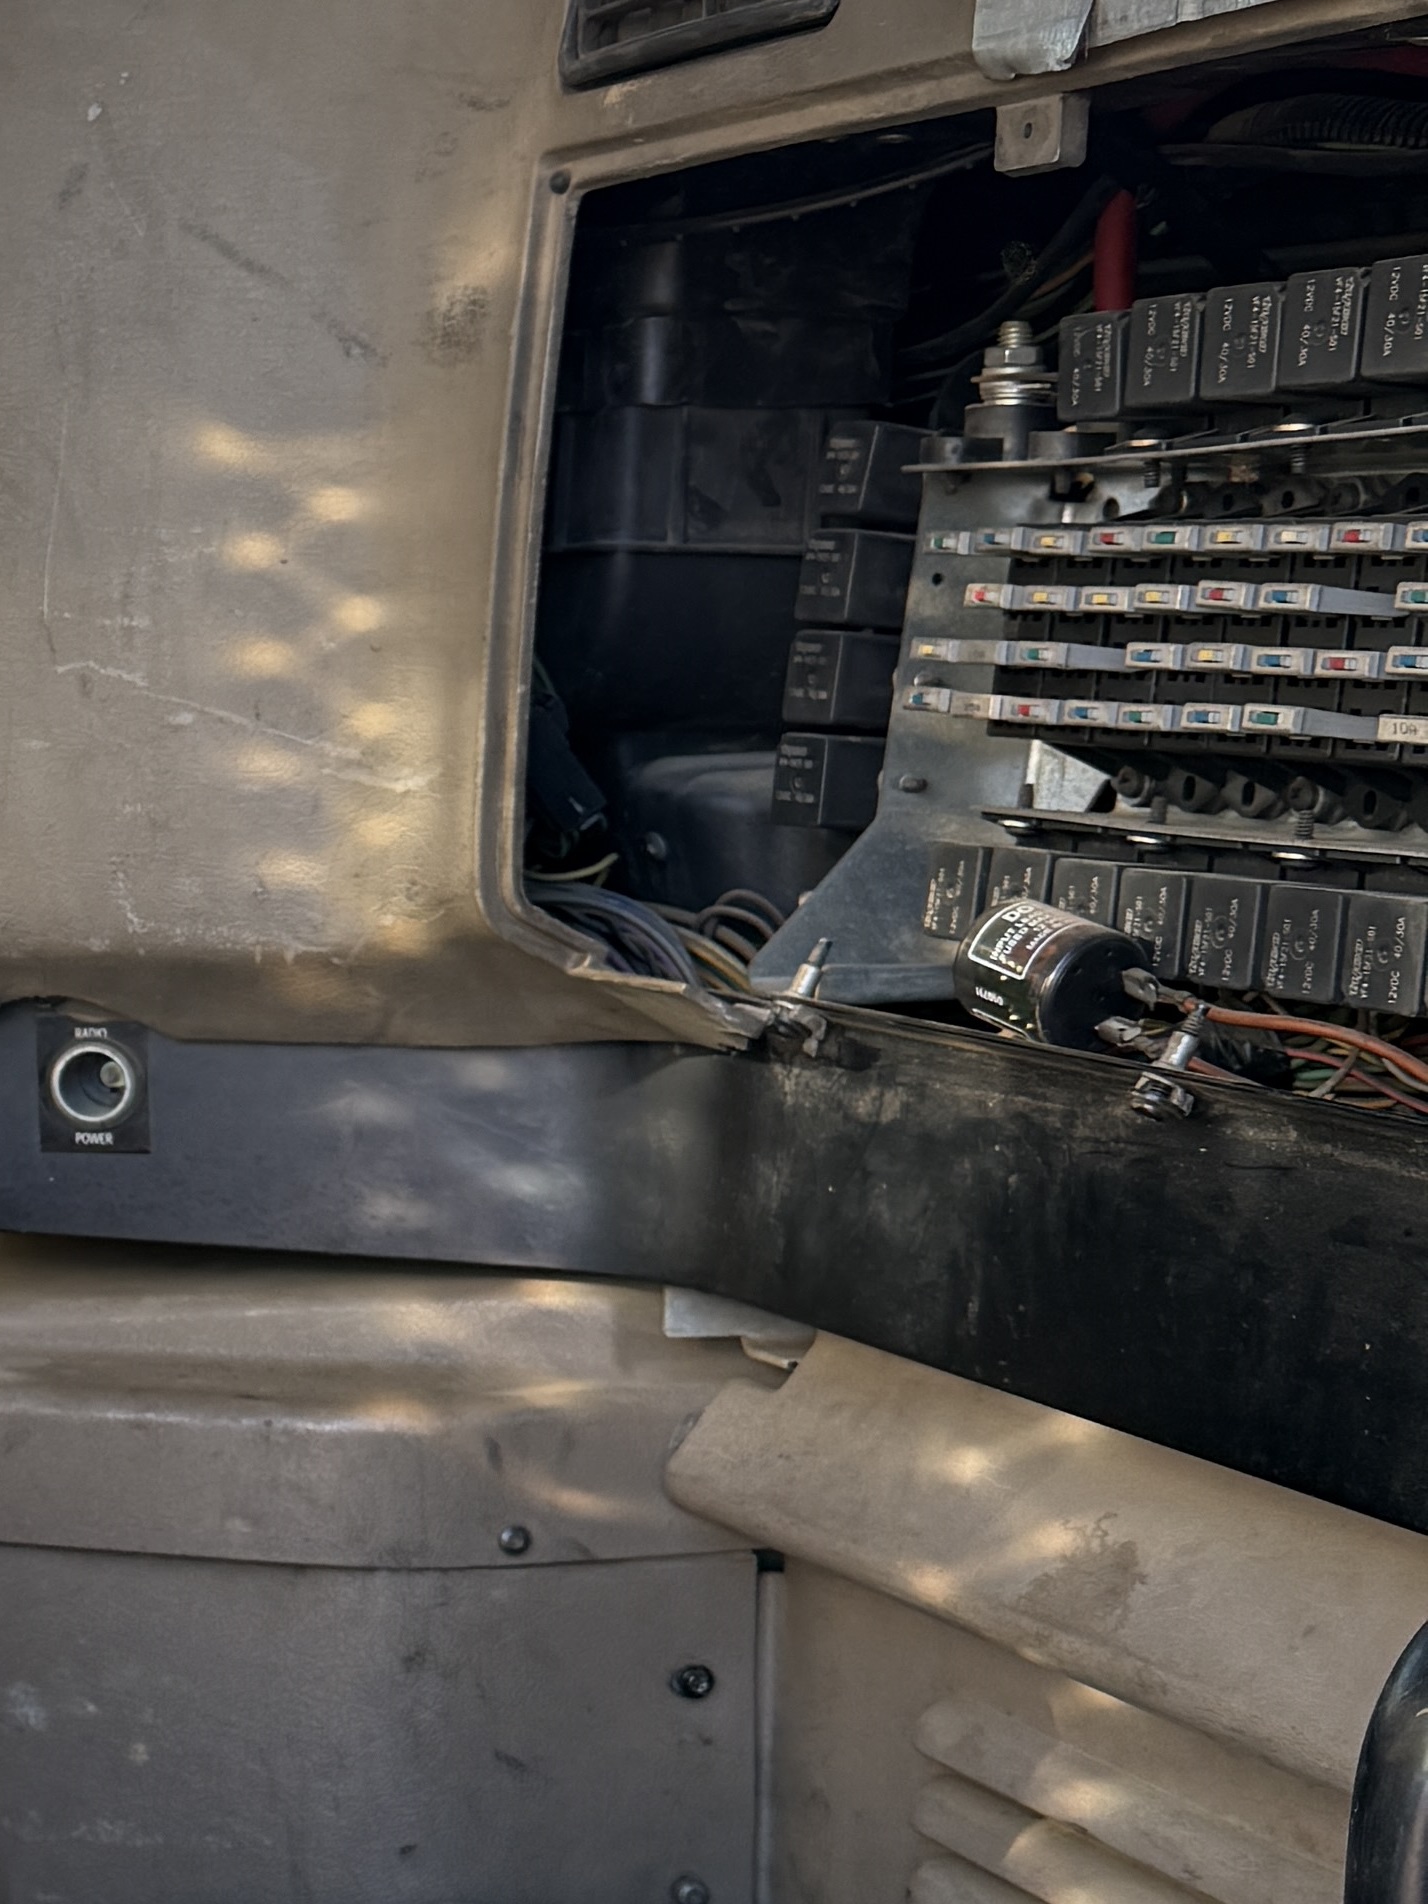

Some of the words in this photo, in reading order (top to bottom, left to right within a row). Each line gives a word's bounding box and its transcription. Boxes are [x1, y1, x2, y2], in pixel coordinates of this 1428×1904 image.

[1388, 265, 1401, 300] 12VDC
[74, 1027, 108, 1039] RADIO
[75, 1132, 113, 1145] POWER
